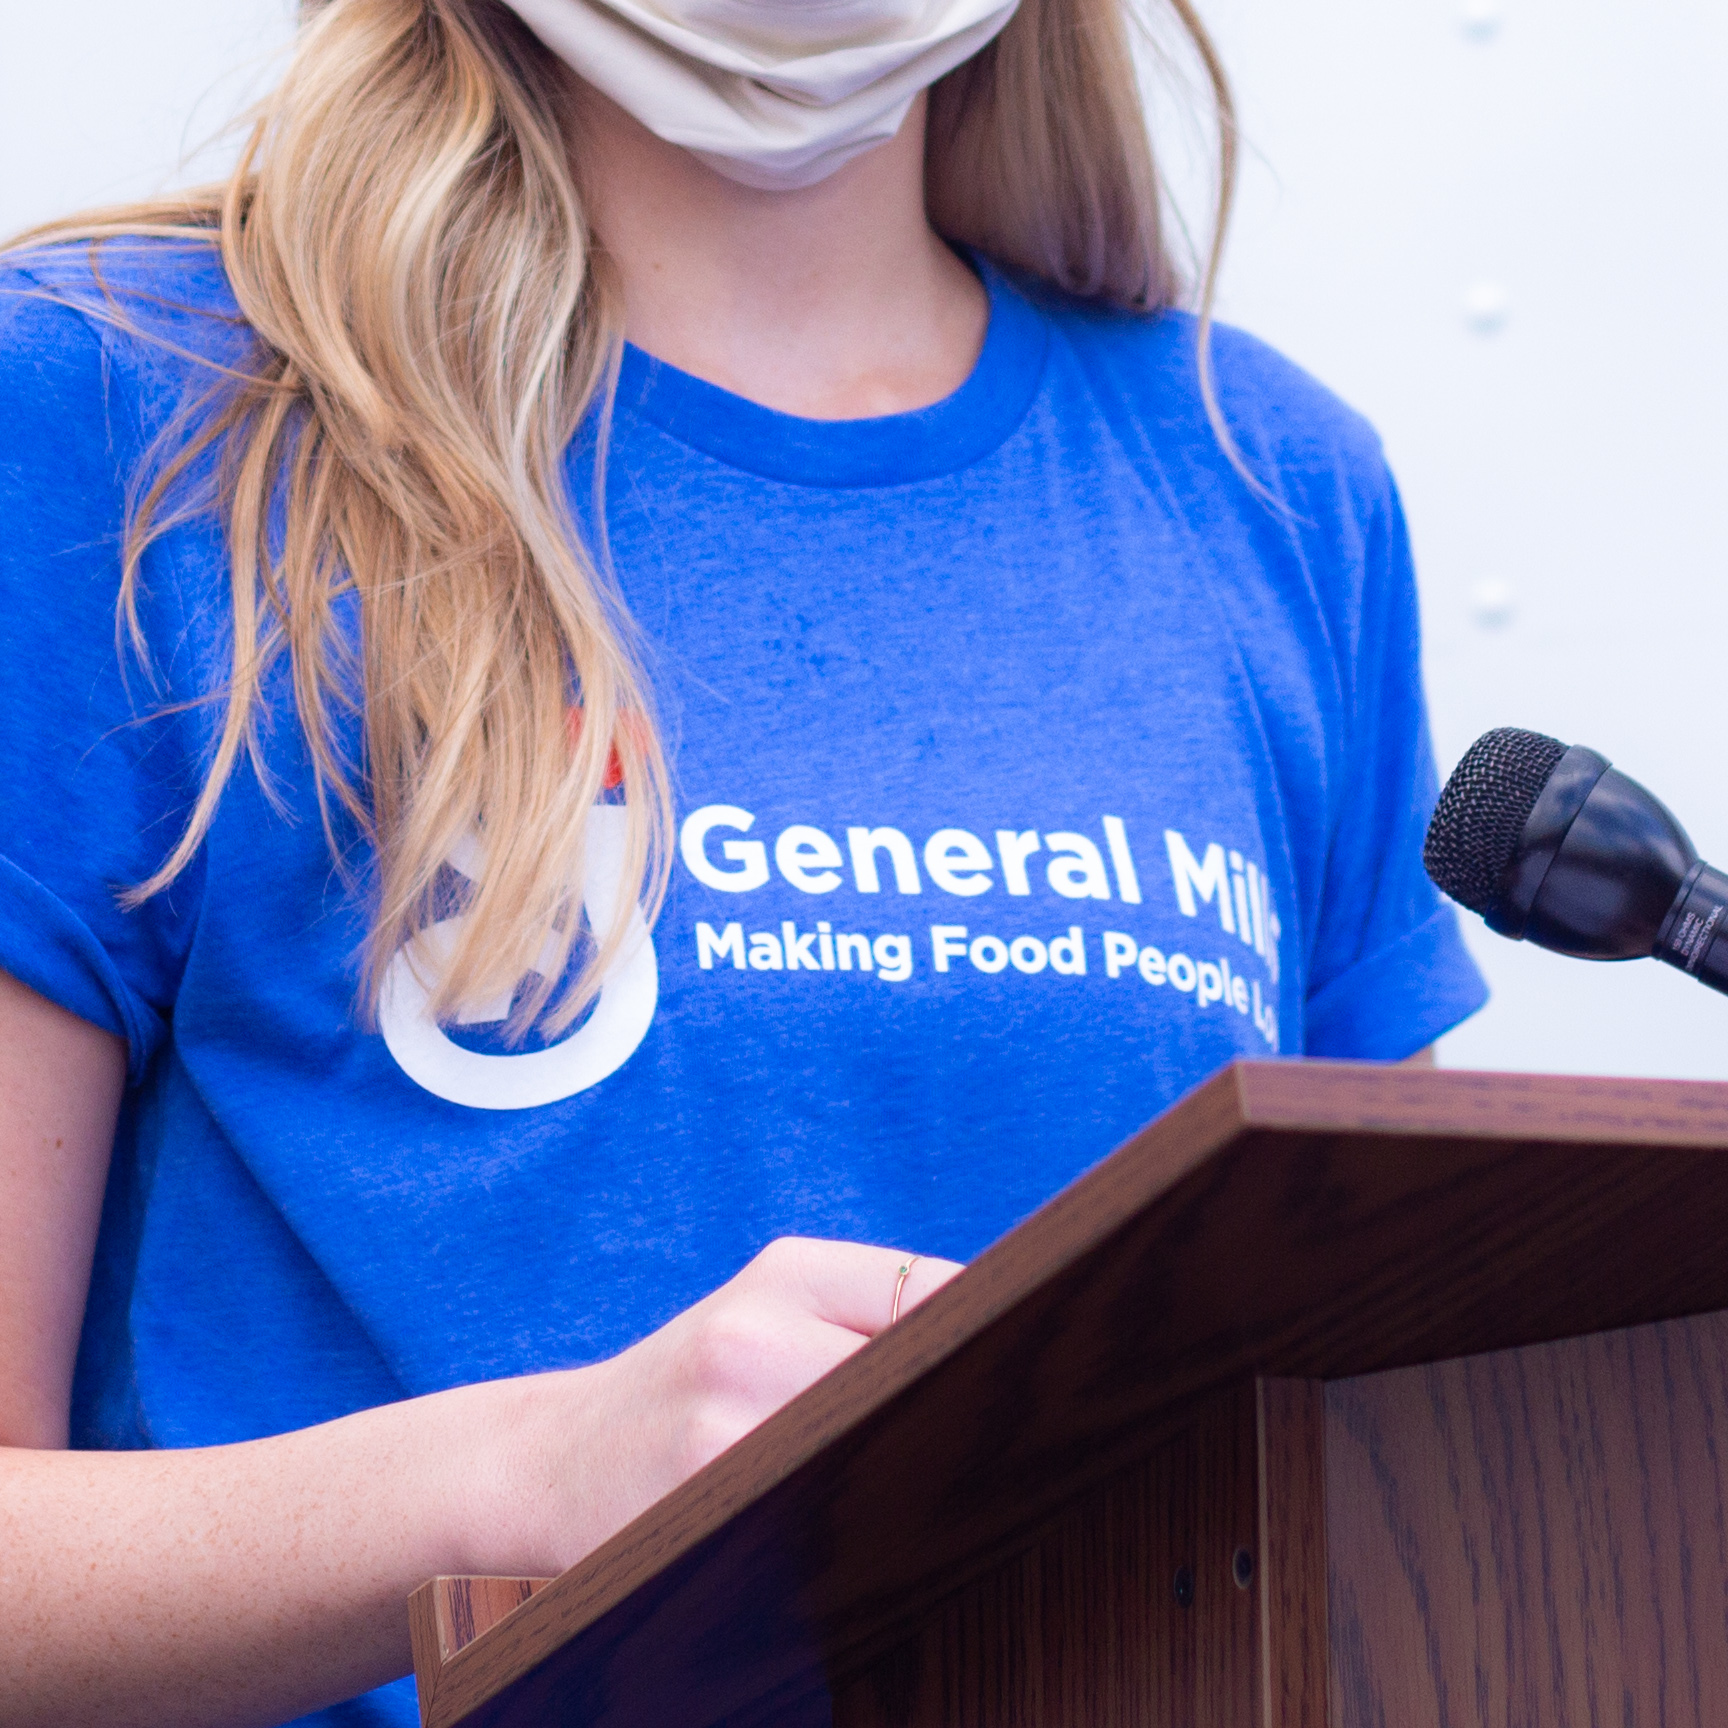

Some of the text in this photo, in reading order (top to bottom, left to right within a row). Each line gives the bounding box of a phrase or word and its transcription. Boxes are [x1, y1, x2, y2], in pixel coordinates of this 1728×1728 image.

[679, 803, 1142, 905] General
[695, 920, 913, 982] Making
[930, 924, 1086, 975] Food
[1103, 931, 1249, 1016] People
[1680, 917, 1705, 957] DYNAMIC
